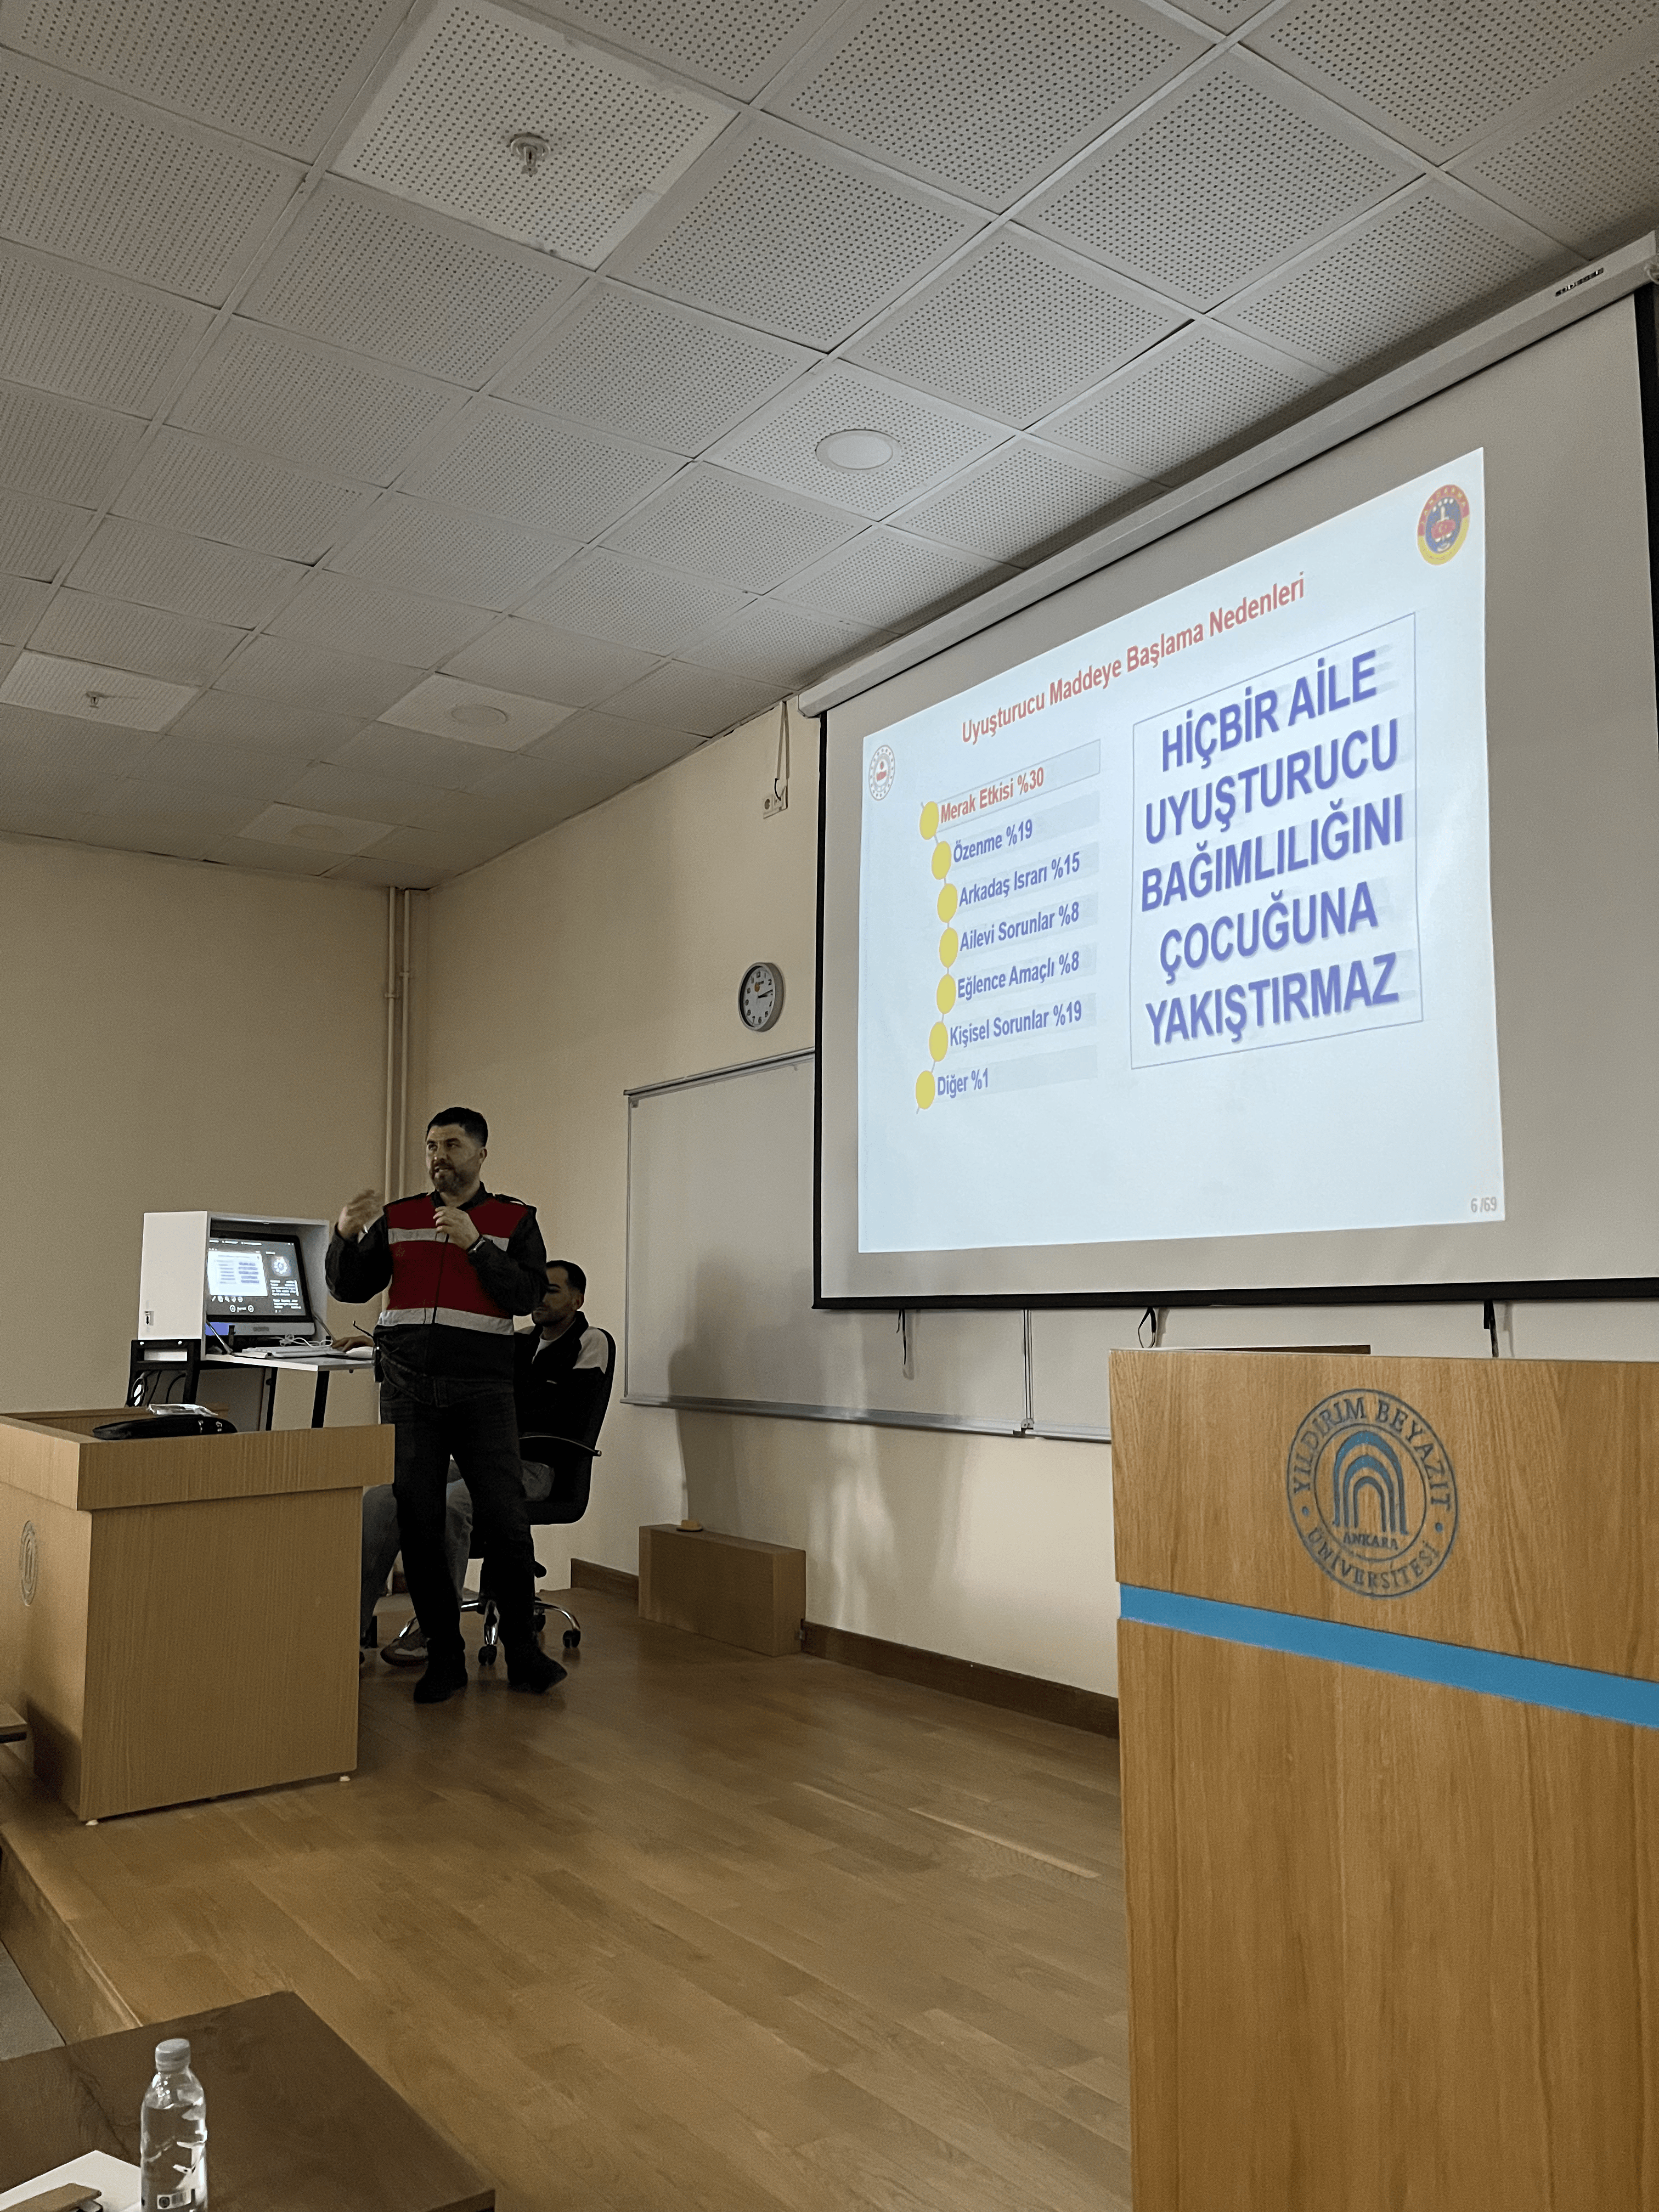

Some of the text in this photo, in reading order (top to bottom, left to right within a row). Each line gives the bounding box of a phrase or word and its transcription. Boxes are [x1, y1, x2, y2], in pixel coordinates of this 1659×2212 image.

[962, 571, 1304, 744] Uyuşturucu Maddeye Başlama Nedenleri
[1163, 650, 1378, 772] HİÇBİR AİLE
[941, 766, 1044, 823] Merak Etkisi %30
[1146, 718, 1398, 844] UYUŞTURUCU
[953, 819, 1032, 863] Özenme %19
[1142, 793, 1403, 912] BAĞIMLILIĞINI
[959, 851, 1080, 907] Arkadaş Israrı %15
[960, 902, 1079, 951] Ailevi Sorunlar %8
[1160, 881, 1378, 985] ÇOCUĞUNA
[958, 951, 1079, 1001] Eğlence Amaçlı %8
[1146, 952, 1400, 1045] YAKIŞTIRMAZ
[950, 1000, 1082, 1048] Kişisel Sorunlar %19
[938, 1068, 988, 1099] Diğer %1
[1293, 1397, 1451, 1511] YILDIRIM BEYAZIT
[1343, 1532, 1398, 1550] ANKARA
